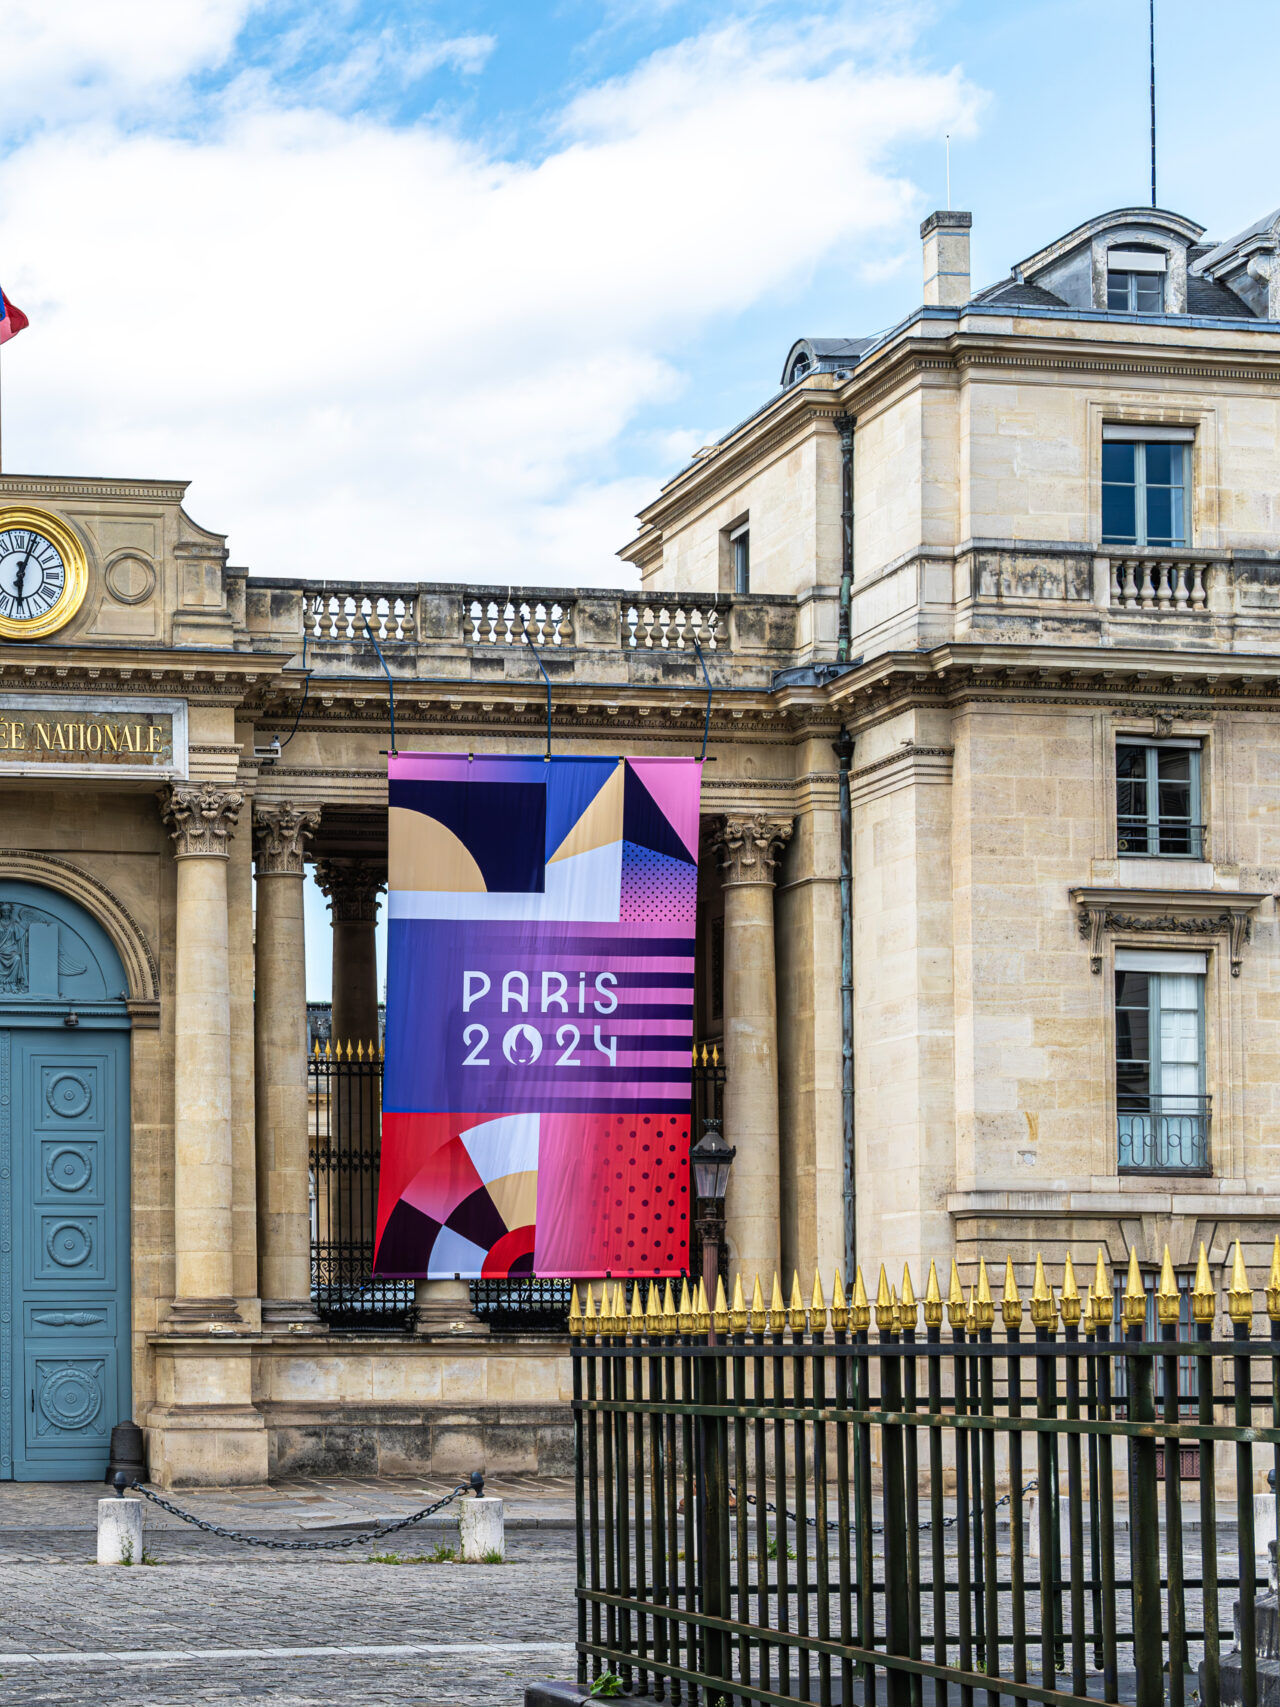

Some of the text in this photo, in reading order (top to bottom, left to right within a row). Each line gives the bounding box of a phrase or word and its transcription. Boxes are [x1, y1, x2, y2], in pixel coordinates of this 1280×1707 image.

[14, 535, 25, 549] XII
[32, 597, 42, 611] V
[35, 722, 163, 753] NATIONALE
[461, 1023, 617, 1067] 2024
